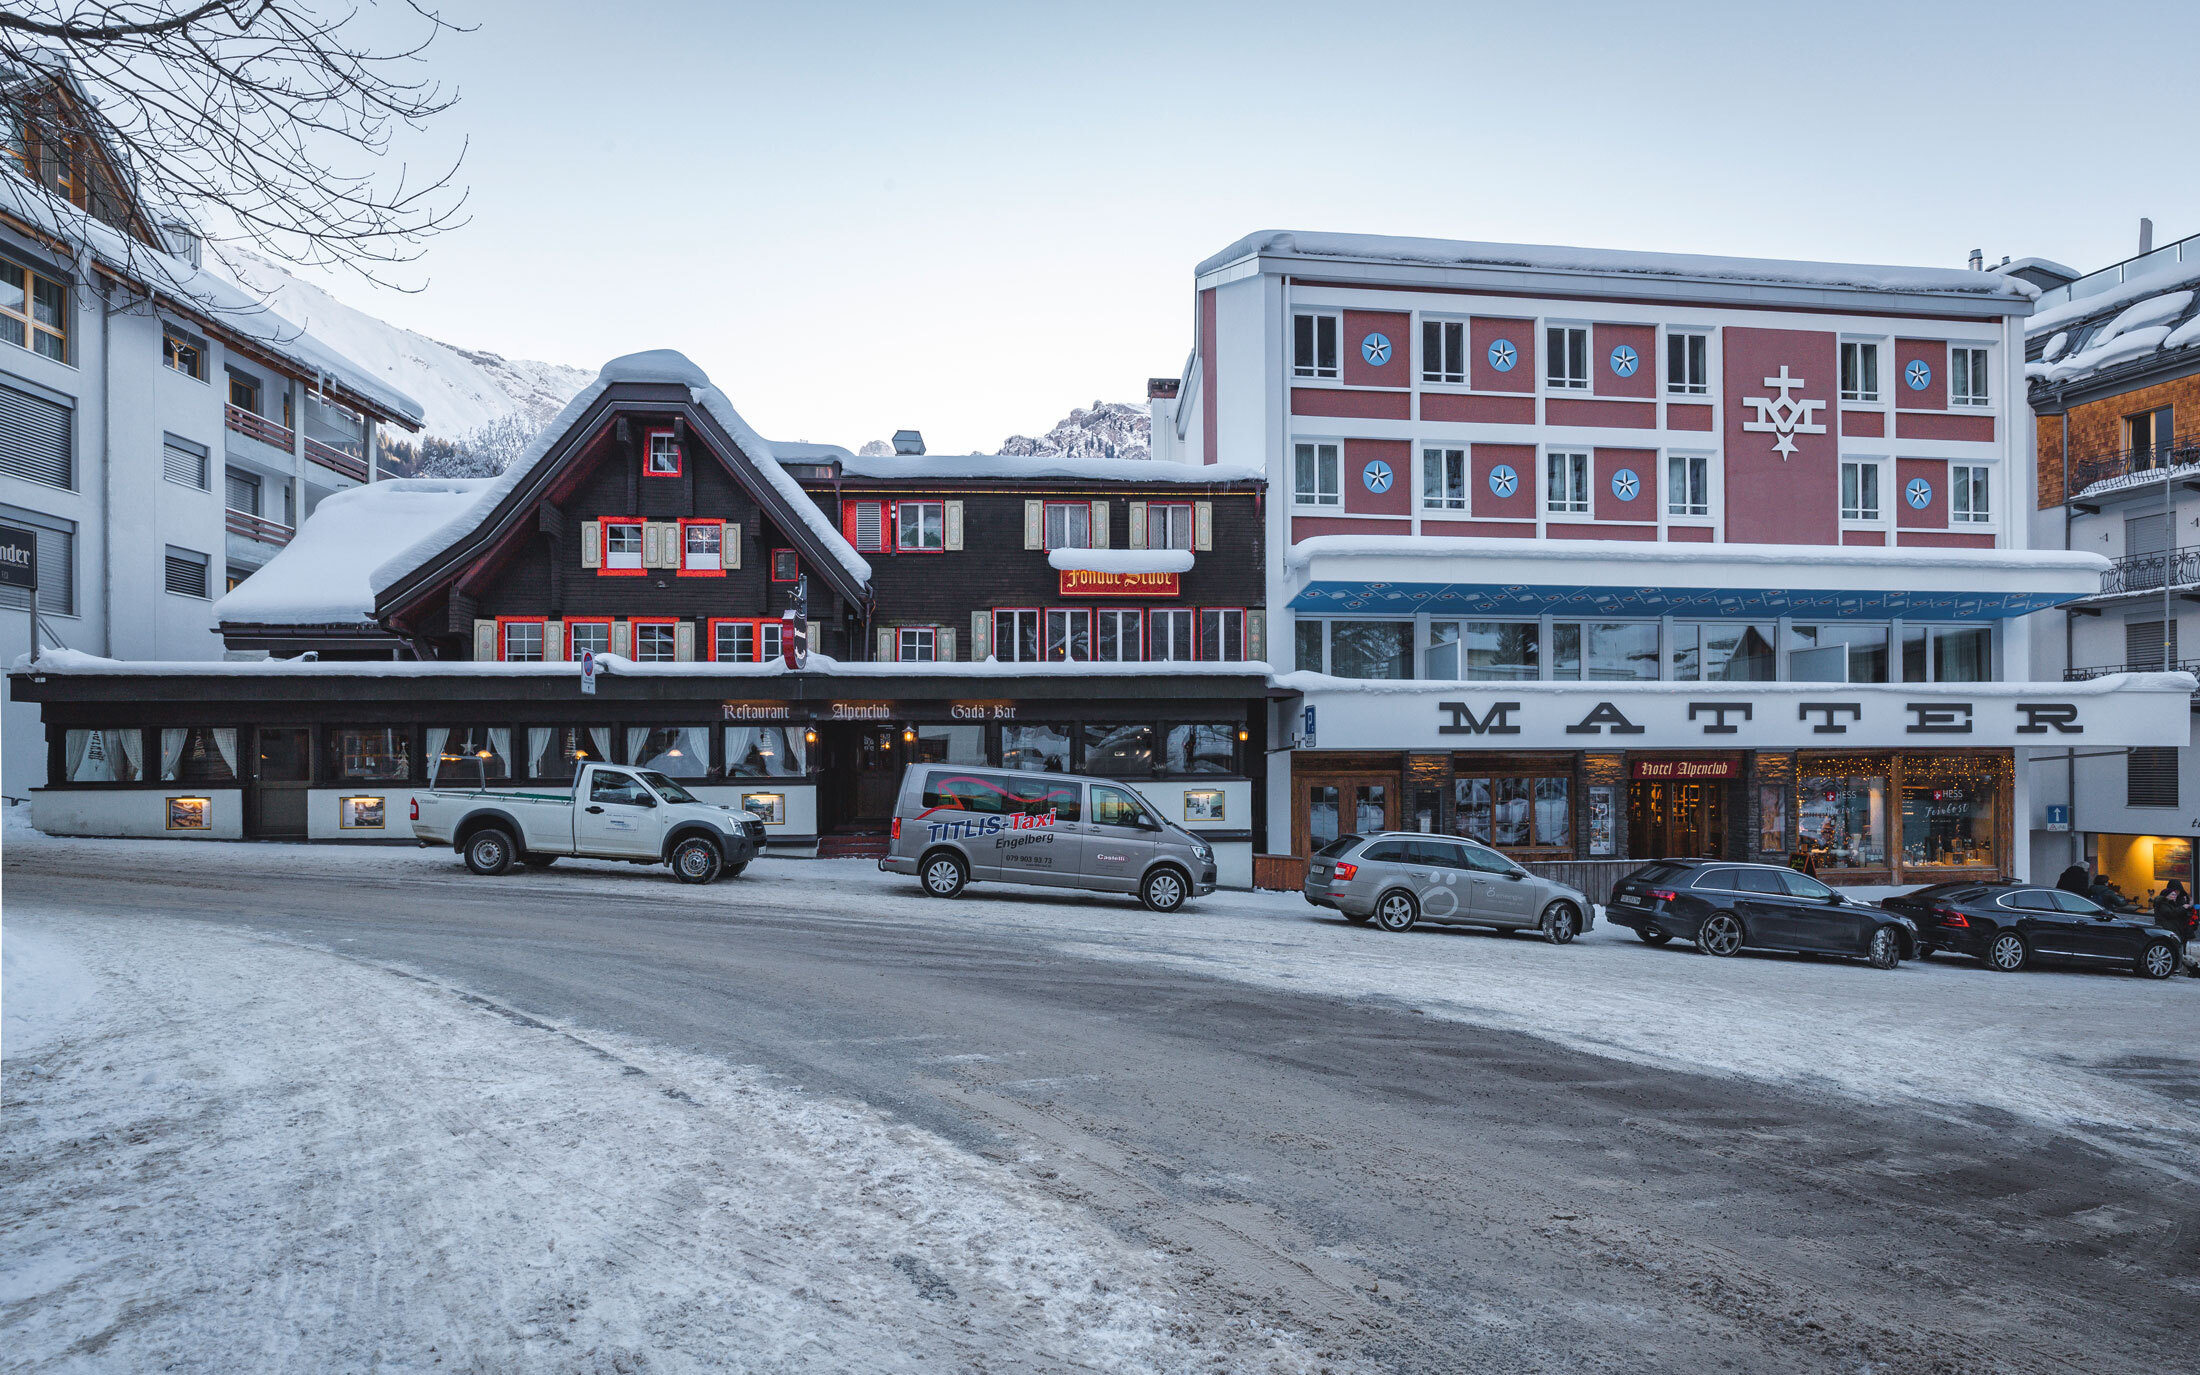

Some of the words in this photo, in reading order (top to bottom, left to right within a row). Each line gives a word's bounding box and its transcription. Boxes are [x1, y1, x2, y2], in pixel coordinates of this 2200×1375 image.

[832, 703, 890, 721] Alpenclub
[951, 704, 985, 719] Gadä
[993, 704, 1016, 719] Bar
[1438, 701, 2084, 734] MATTER
[1641, 761, 1673, 776] Hotel
[1677, 761, 1728, 778] Alpenclub
[1836, 790, 1857, 800] HESS
[1942, 789, 1964, 798] HESS
[927, 807, 1057, 844] TITLIS-Taxi
[995, 833, 1055, 849] Engelberg
[1006, 854, 1019, 862] 079
[1045, 857, 1053, 865] 73
